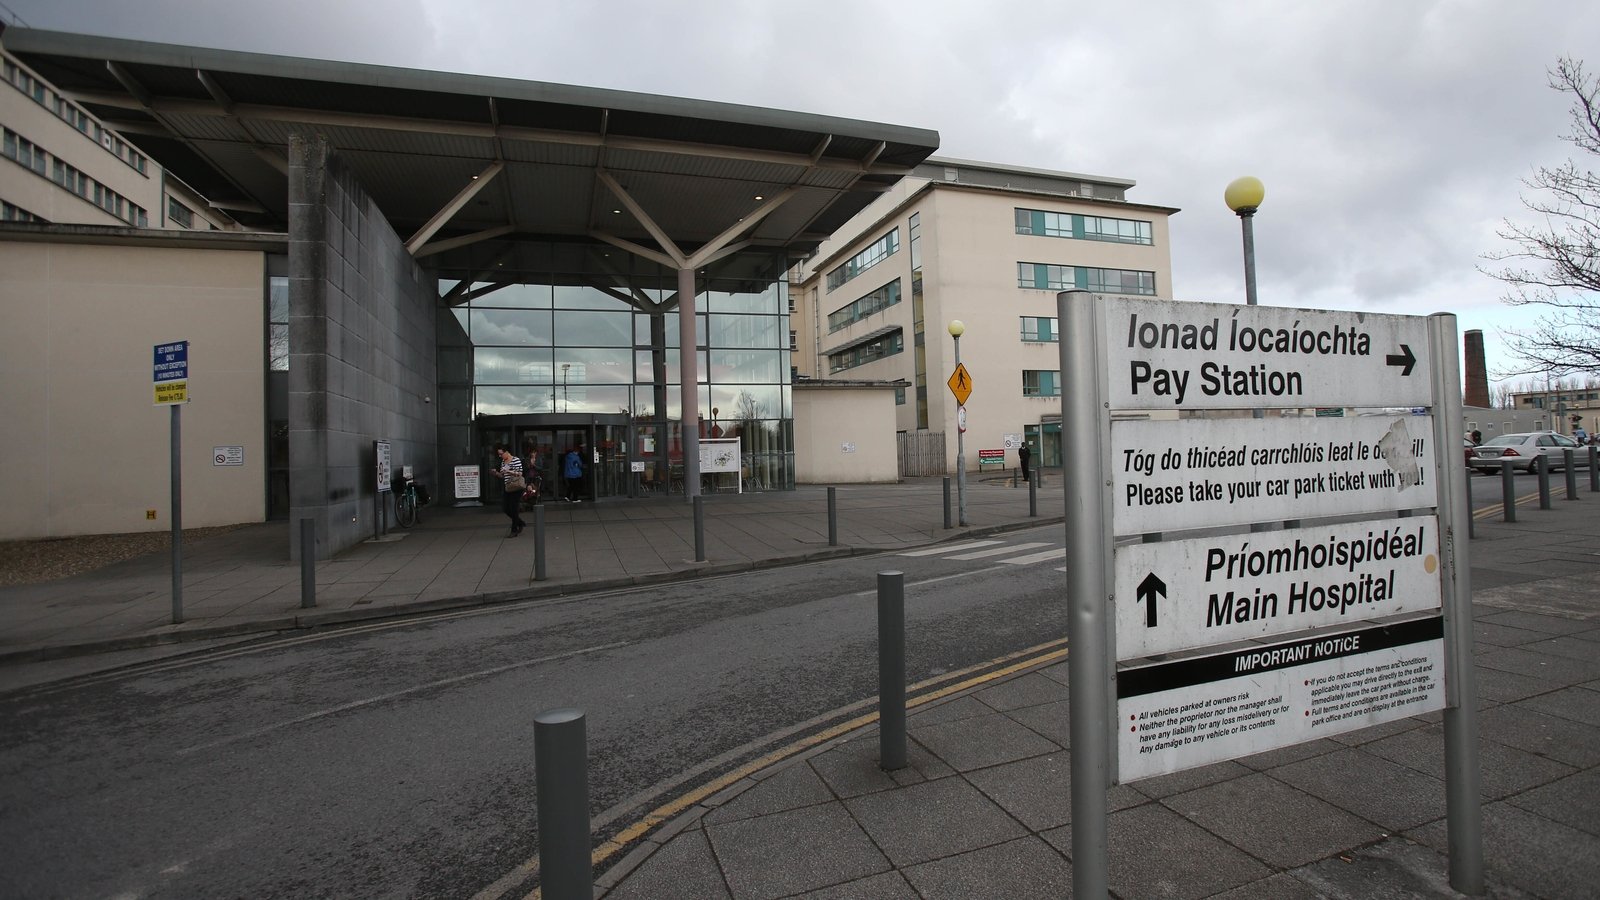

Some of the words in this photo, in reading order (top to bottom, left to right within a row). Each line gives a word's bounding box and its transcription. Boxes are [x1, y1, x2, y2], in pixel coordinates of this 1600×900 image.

[1128, 313, 1219, 350] Ionad
[1130, 360, 1190, 404] Pay
[1201, 362, 1302, 396] Station
[1124, 449, 1155, 476] Tóg
[1161, 448, 1181, 470] do
[1187, 445, 1247, 469] thicéad
[1251, 443, 1324, 466] carrchlóis
[1328, 442, 1353, 462] leat
[1357, 441, 1369, 460] le
[1126, 484, 1184, 506] Please
[1189, 480, 1223, 501] take
[1228, 481, 1261, 503] your
[1266, 479, 1290, 496] car
[1294, 473, 1325, 499] park
[1329, 471, 1365, 491] ticket
[1205, 527, 1424, 582] Príomhoispidéal
[1206, 588, 1278, 628] Main
[1288, 570, 1395, 615] Hospital
[1235, 645, 1311, 672] IMPORTANT
[1314, 635, 1360, 657] NOTICE
[1139, 712, 1148, 720] All
[1150, 707, 1178, 718] vehicles
[1179, 700, 1203, 714] parked
[1205, 699, 1211, 707] at
[1213, 696, 1236, 705] owners
[1238, 692, 1249, 701] risk
[1139, 721, 1165, 731] Neither
[1167, 718, 1177, 726] the
[1179, 711, 1213, 724] proprietor
[1214, 708, 1226, 716] nor
[1239, 700, 1267, 711] manager
[1268, 695, 1282, 706] shall
[1140, 734, 1156, 743] have
[1158, 729, 1170, 739] any
[1172, 725, 1196, 736] liability
[1198, 721, 1207, 730] for
[1209, 719, 1221, 730] any
[1222, 717, 1235, 726] loss
[1236, 710, 1271, 723] misdelivery
[1140, 743, 1153, 754] Any
[1155, 739, 1182, 750] damage
[1193, 734, 1204, 744] any
[1206, 728, 1229, 739] vehicle
[1248, 719, 1276, 731] contents
